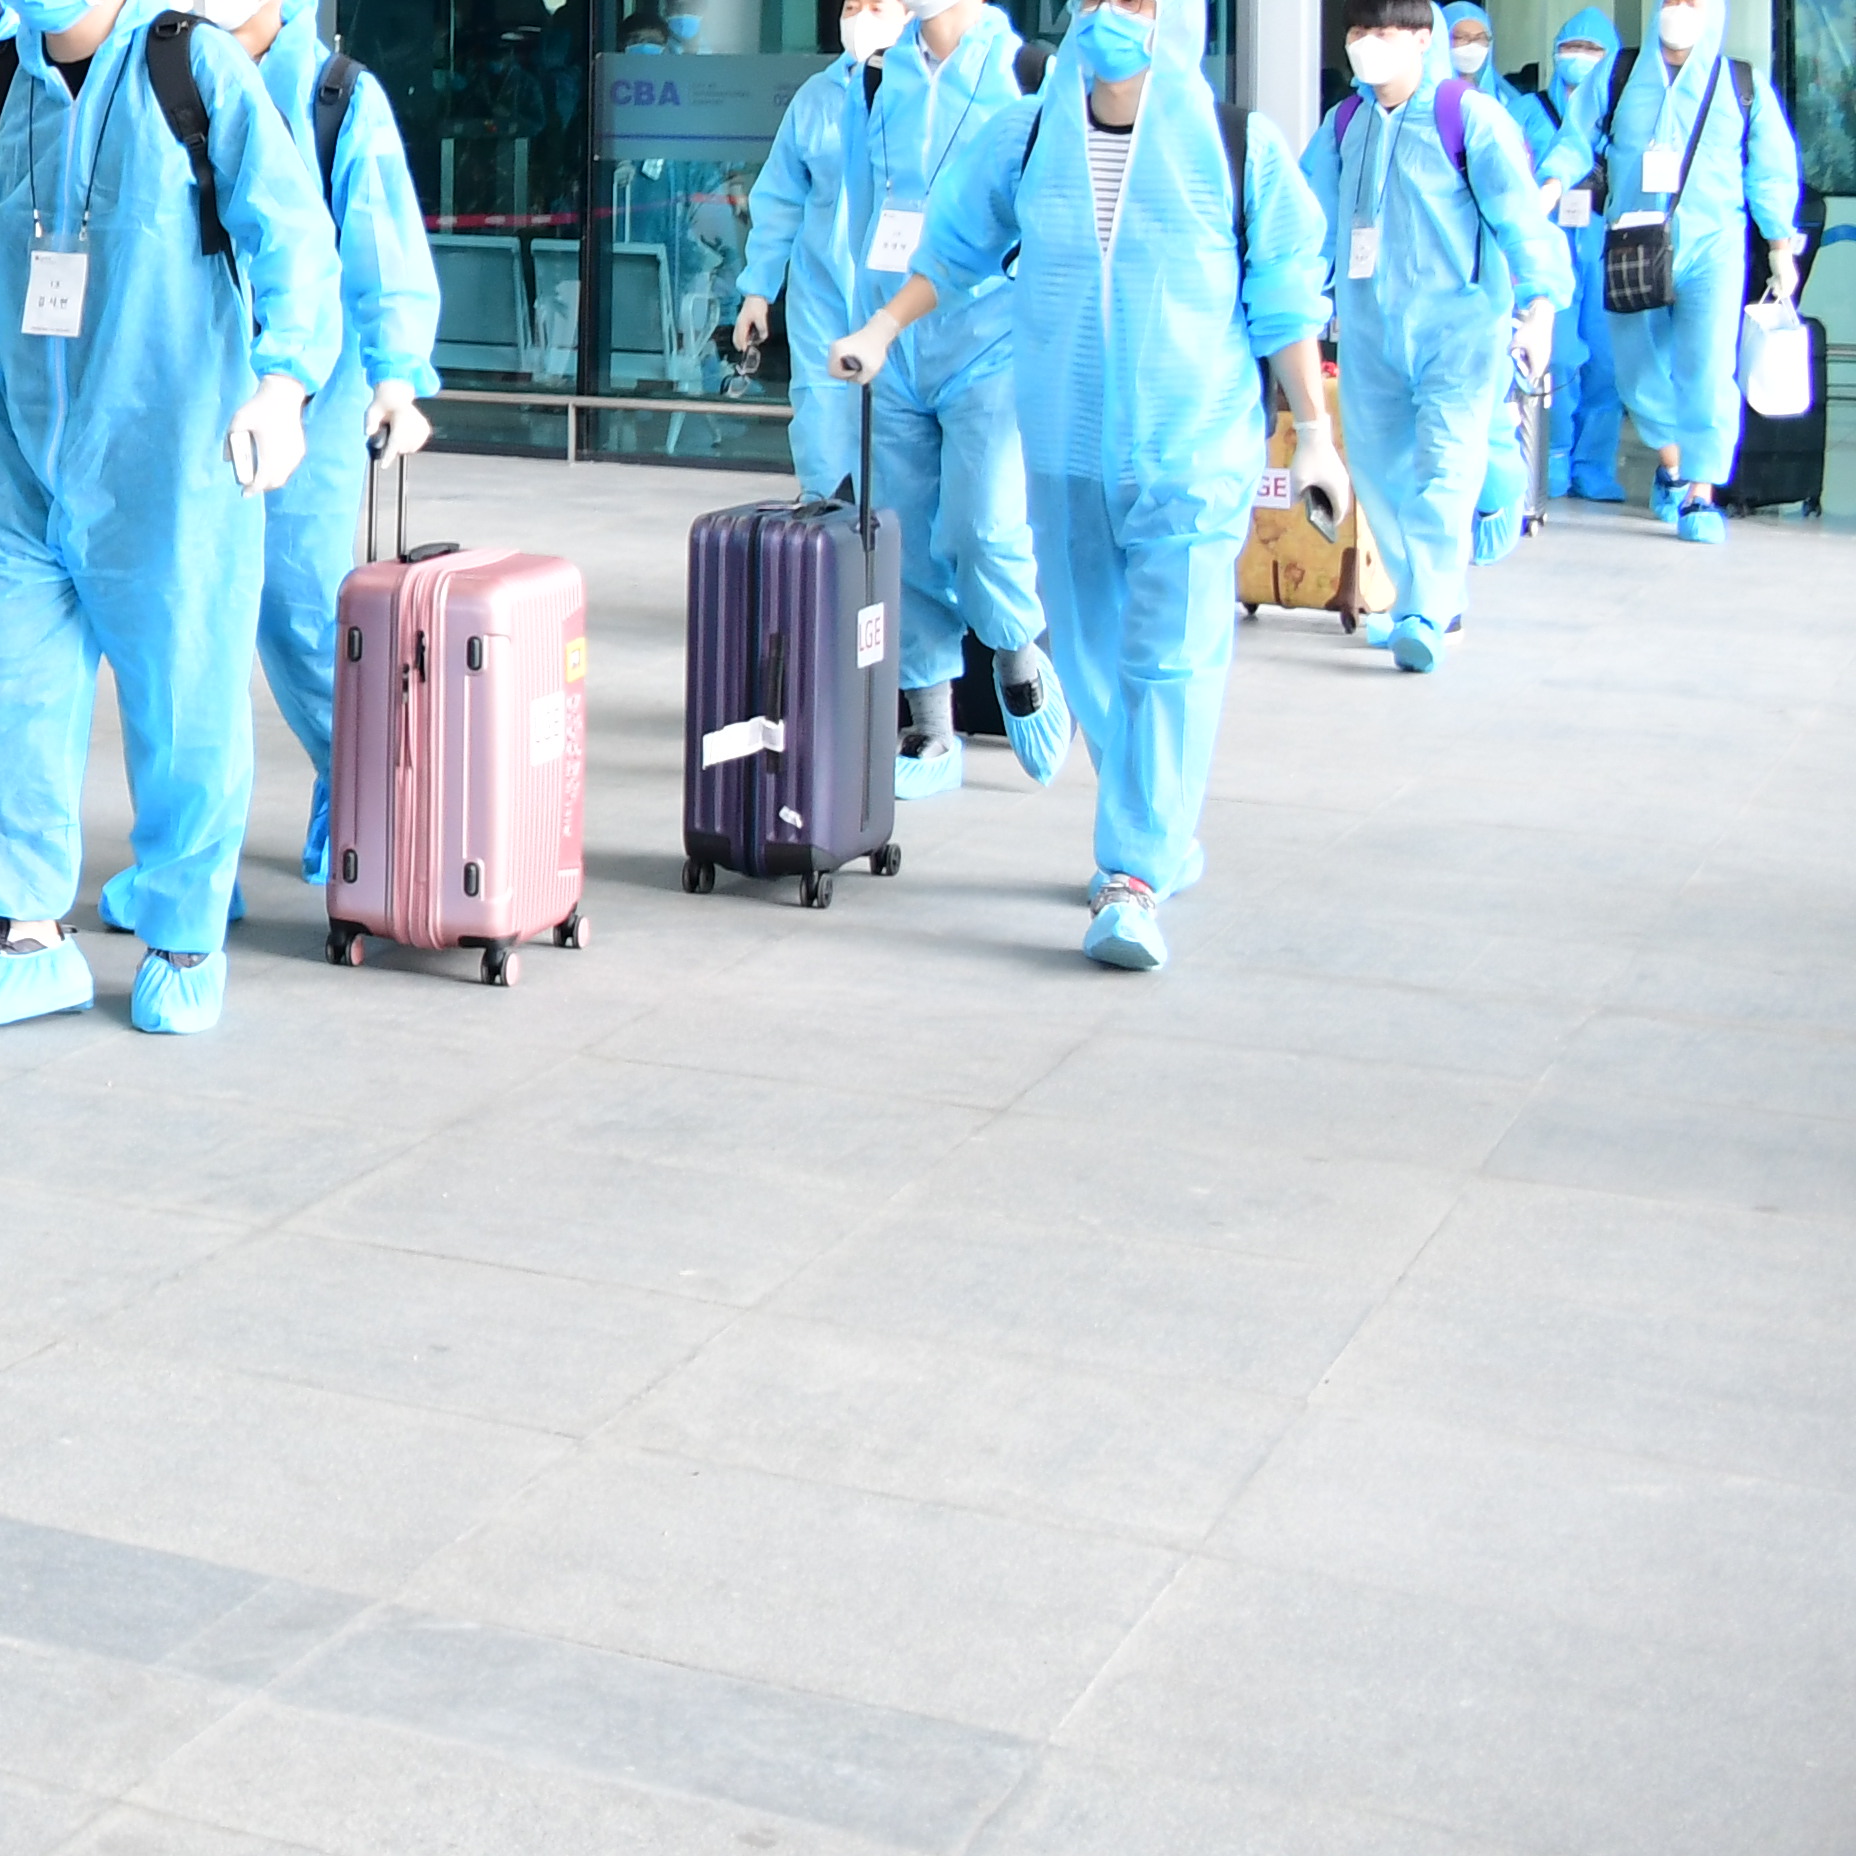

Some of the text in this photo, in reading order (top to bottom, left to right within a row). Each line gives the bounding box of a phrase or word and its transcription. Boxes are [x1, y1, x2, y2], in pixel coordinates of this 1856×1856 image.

[610, 79, 681, 106] CBA
[1256, 476, 1287, 498] GE
[858, 614, 884, 654] LGE
